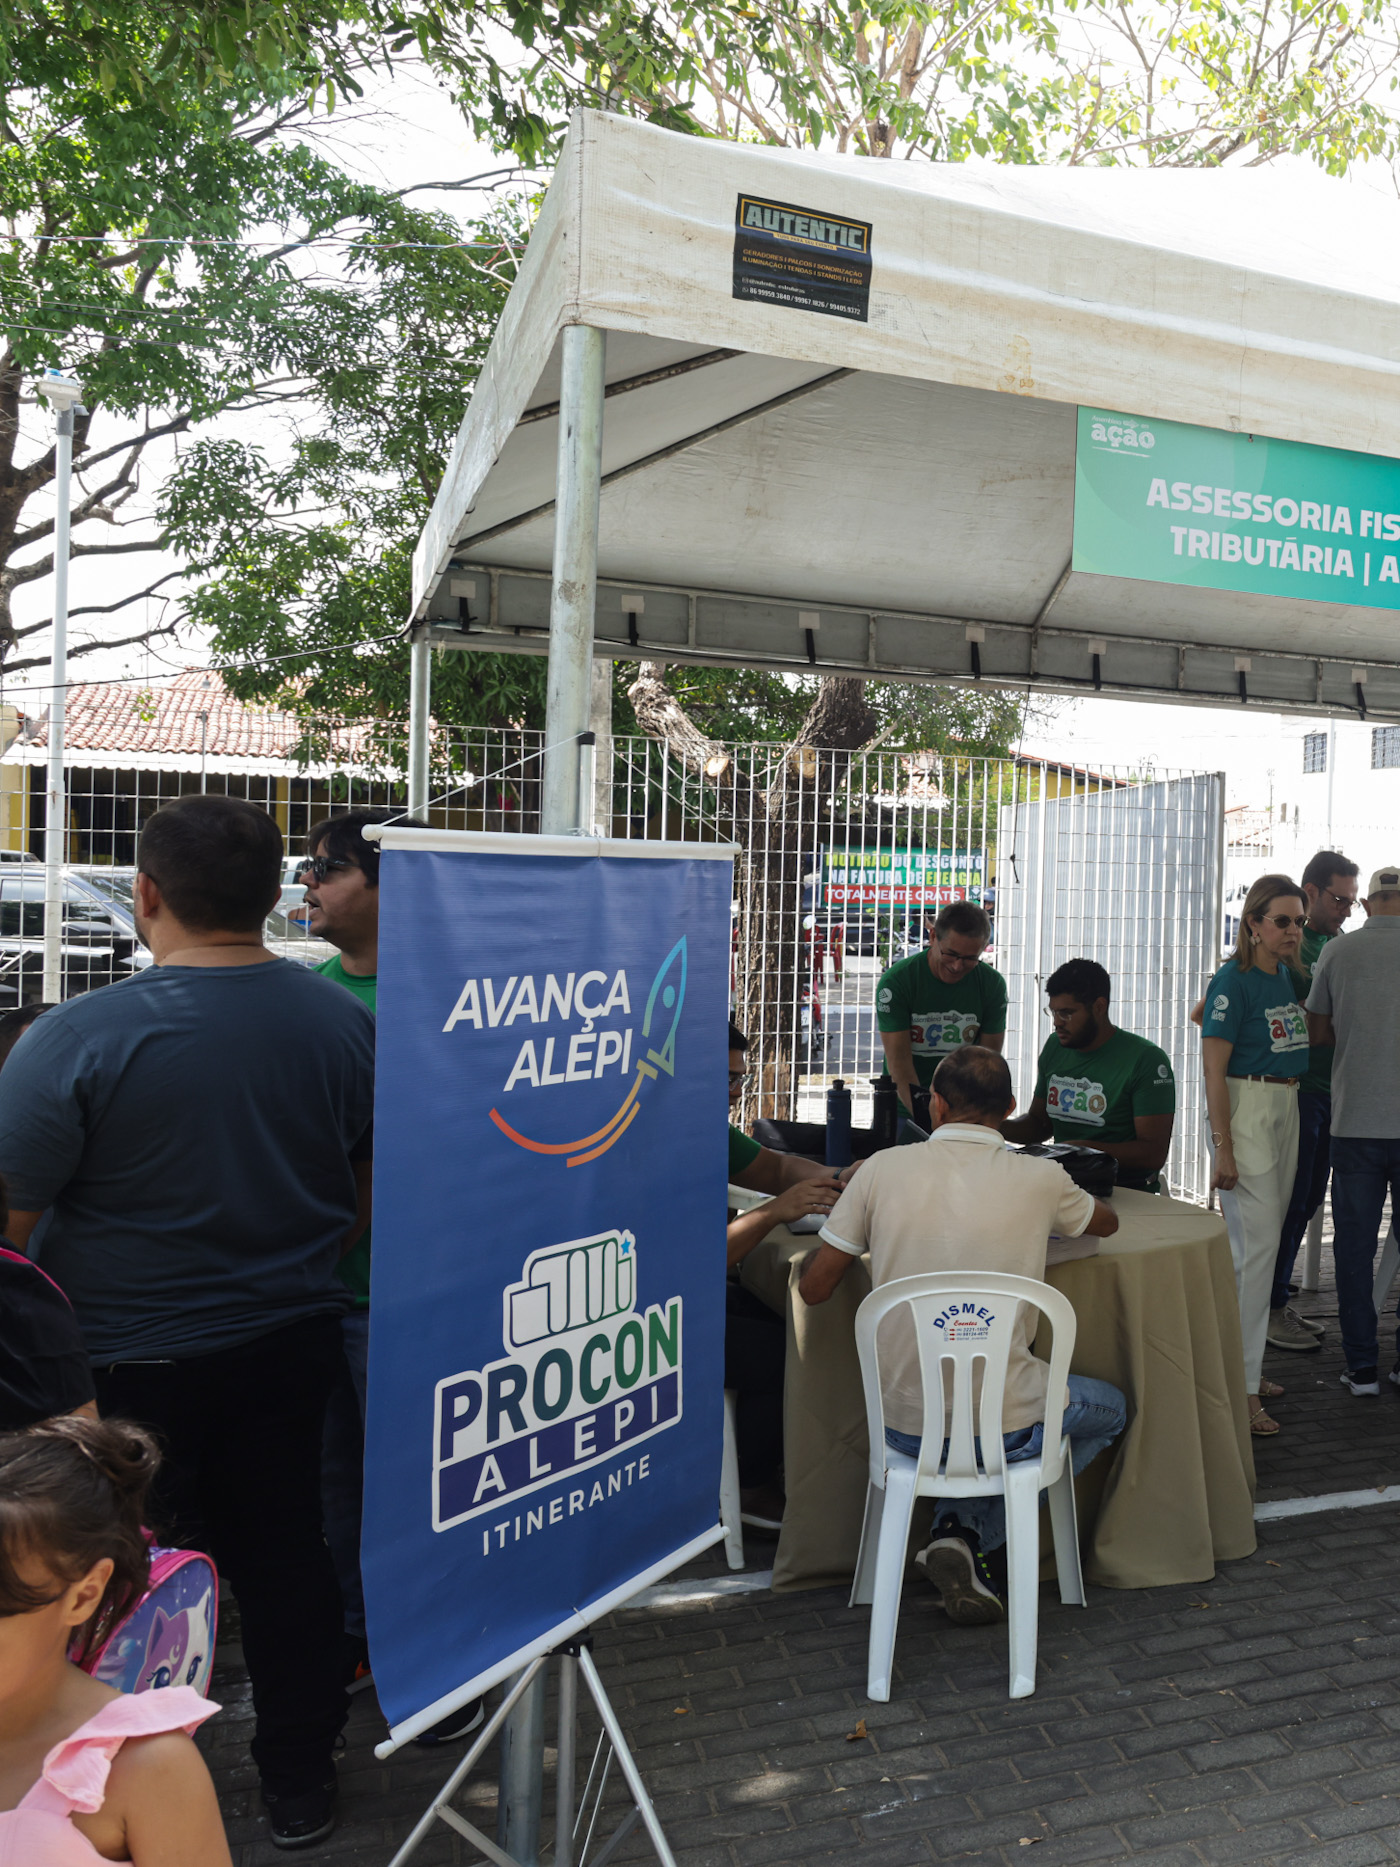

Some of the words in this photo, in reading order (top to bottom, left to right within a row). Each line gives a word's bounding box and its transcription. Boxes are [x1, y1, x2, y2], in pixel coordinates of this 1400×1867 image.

[745, 204, 863, 250] AUTENTIC
[743, 249, 783, 261] GERADORES
[788, 258, 813, 268] PALCOS
[787, 265, 813, 276] TENDAS
[817, 271, 842, 282] STANDS
[846, 277, 863, 285] LEDS
[749, 287, 758, 295] 86
[1146, 477, 1353, 537] ASSESSORIA
[1170, 526, 1355, 578] TRIBUTÁRIA
[827, 888, 913, 900] TOTALMENTE
[851, 870, 901, 885] FATURA
[442, 969, 632, 1034] AVANÇA
[503, 1028, 633, 1092] ALEPI
[933, 1302, 996, 1329] DISMEL
[439, 1302, 679, 1464] PROCON
[472, 1400, 661, 1504] ALEPI
[482, 1453, 652, 1558] ITINERANTE
